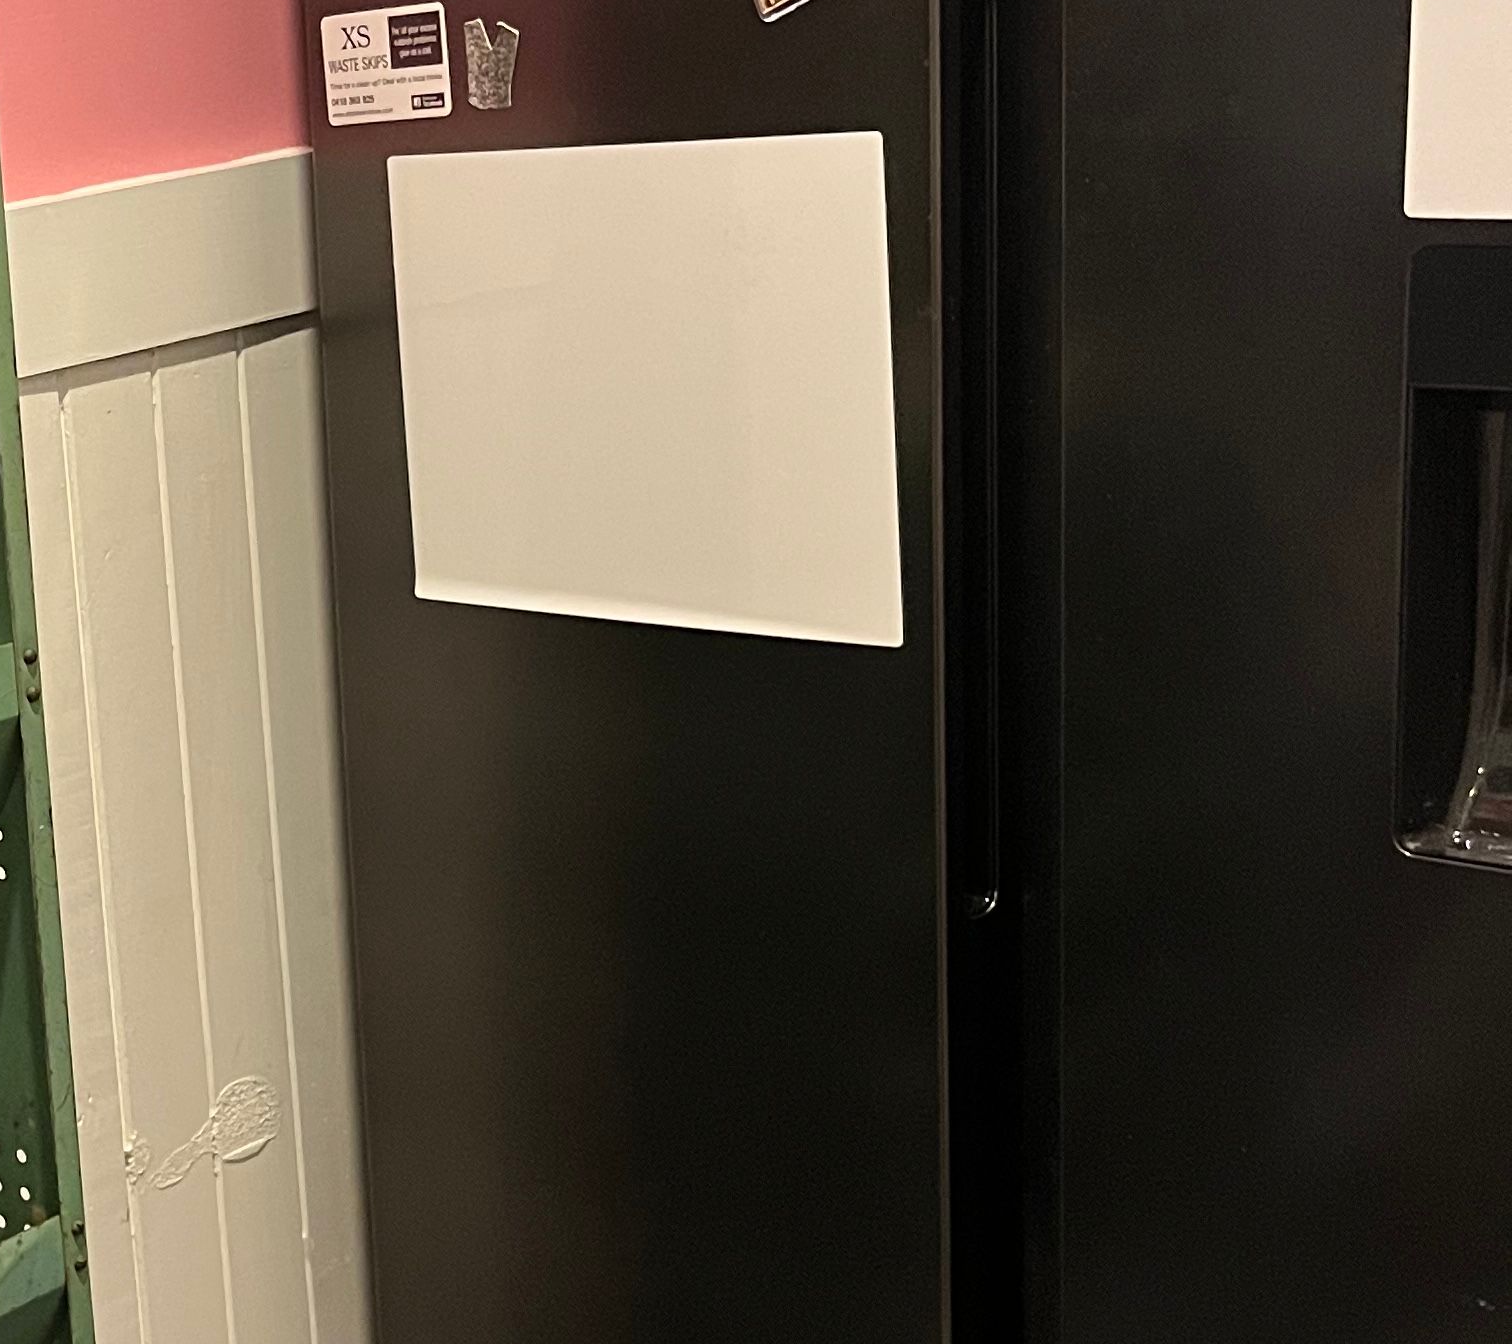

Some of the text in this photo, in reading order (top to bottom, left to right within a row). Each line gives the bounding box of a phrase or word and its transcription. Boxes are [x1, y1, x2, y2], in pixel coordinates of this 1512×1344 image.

[341, 24, 372, 51] XS
[328, 54, 389, 75] WASTE SKIPS
